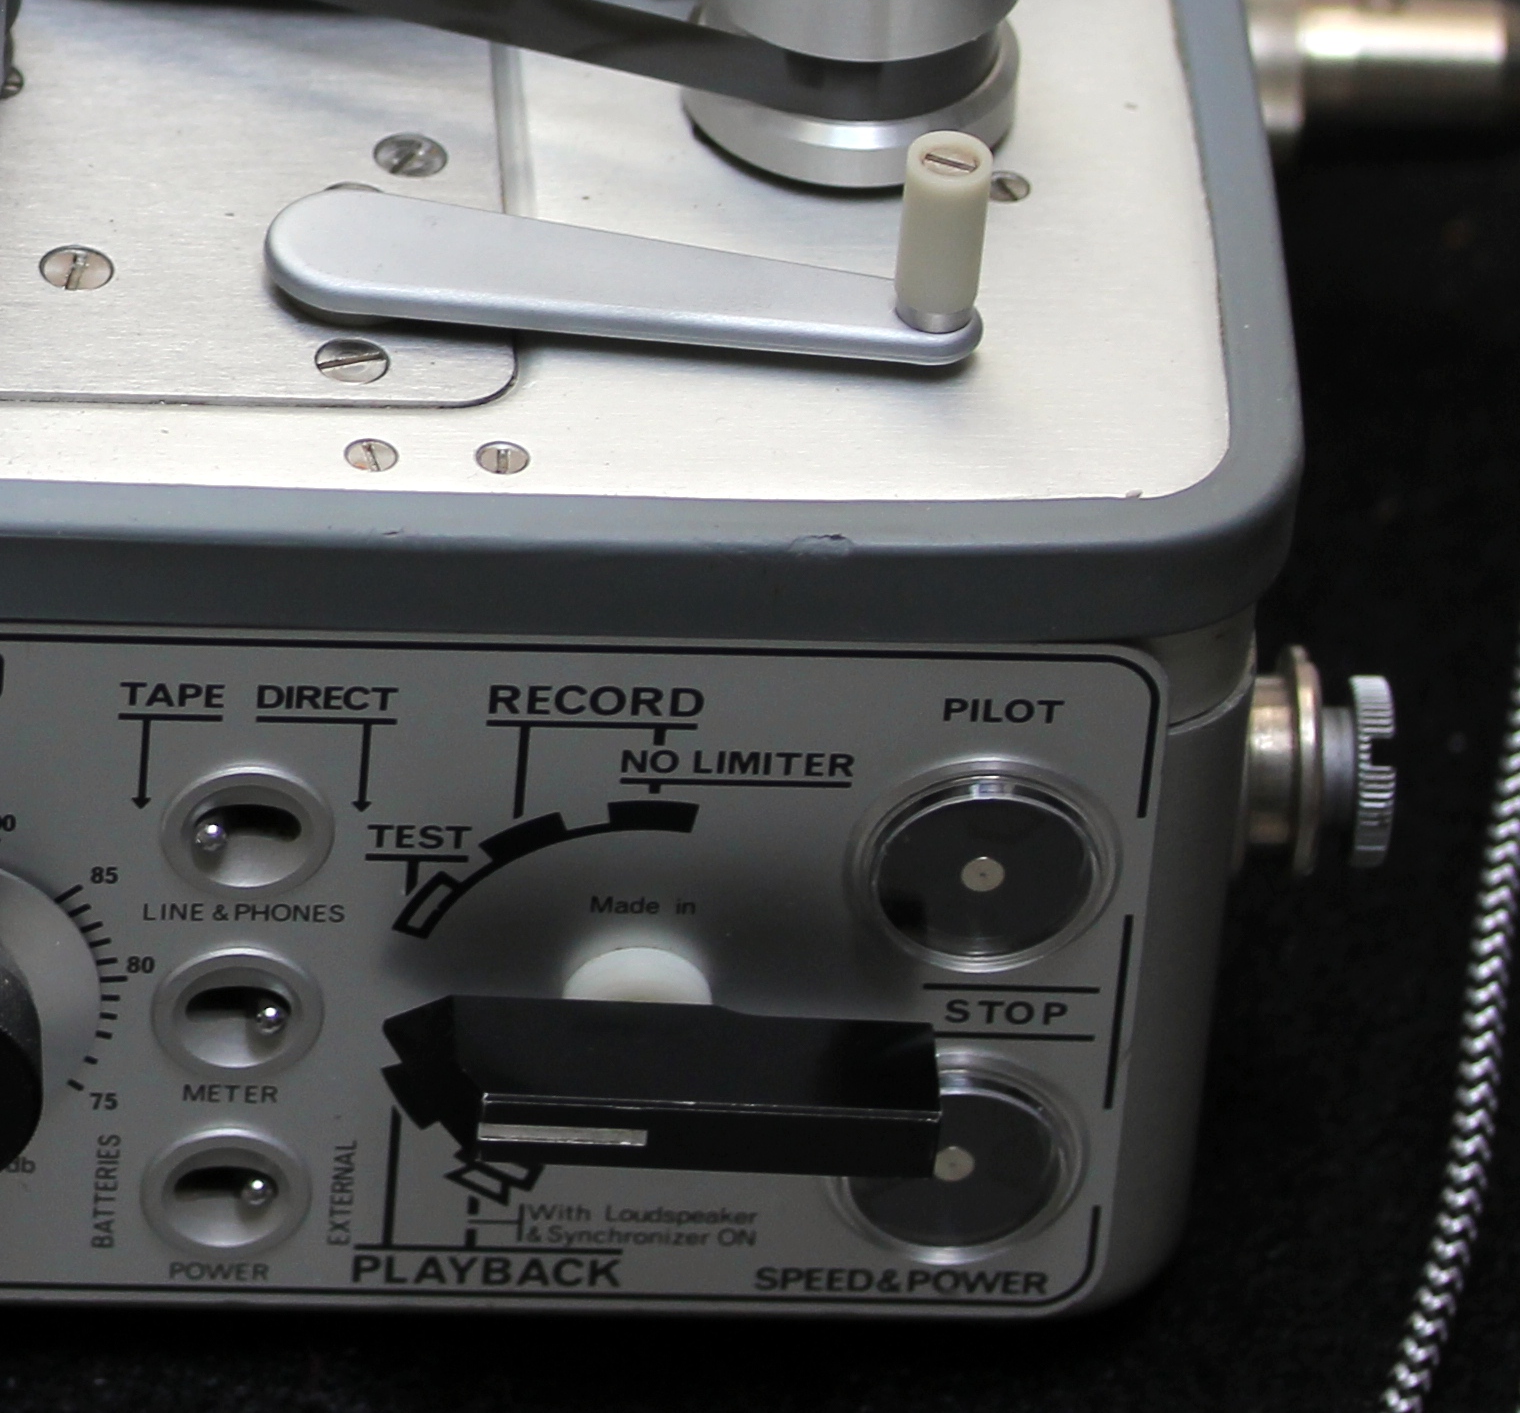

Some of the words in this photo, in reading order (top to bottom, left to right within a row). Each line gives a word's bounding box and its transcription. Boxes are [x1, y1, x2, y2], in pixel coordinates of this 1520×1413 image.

[120, 682, 225, 709] TAPE
[256, 685, 398, 712] DIRECT
[486, 686, 705, 719] RECORD
[942, 698, 1064, 724] PILOT
[621, 751, 679, 775] NO
[692, 751, 854, 778] LIMITER
[367, 825, 471, 849] TEST
[91, 866, 118, 884] 85
[143, 903, 204, 921] LINE
[590, 896, 660, 915] Made
[675, 897, 696, 915] in
[127, 956, 155, 974] 80
[944, 1000, 1068, 1026] STOP
[90, 1093, 117, 1110] 75
[182, 1083, 278, 1104] METER
[91, 1134, 121, 1248] BATTERIES
[326, 1139, 357, 1246] EXTERNAL
[527, 1204, 590, 1222] With
[606, 1205, 757, 1227] Loudspeaker
[526, 1226, 542, 1242] &
[547, 1225, 708, 1247] Synchronizer
[717, 1229, 757, 1246] ON
[169, 1262, 269, 1280] POWER
[351, 1255, 621, 1287] PLAYBACK
